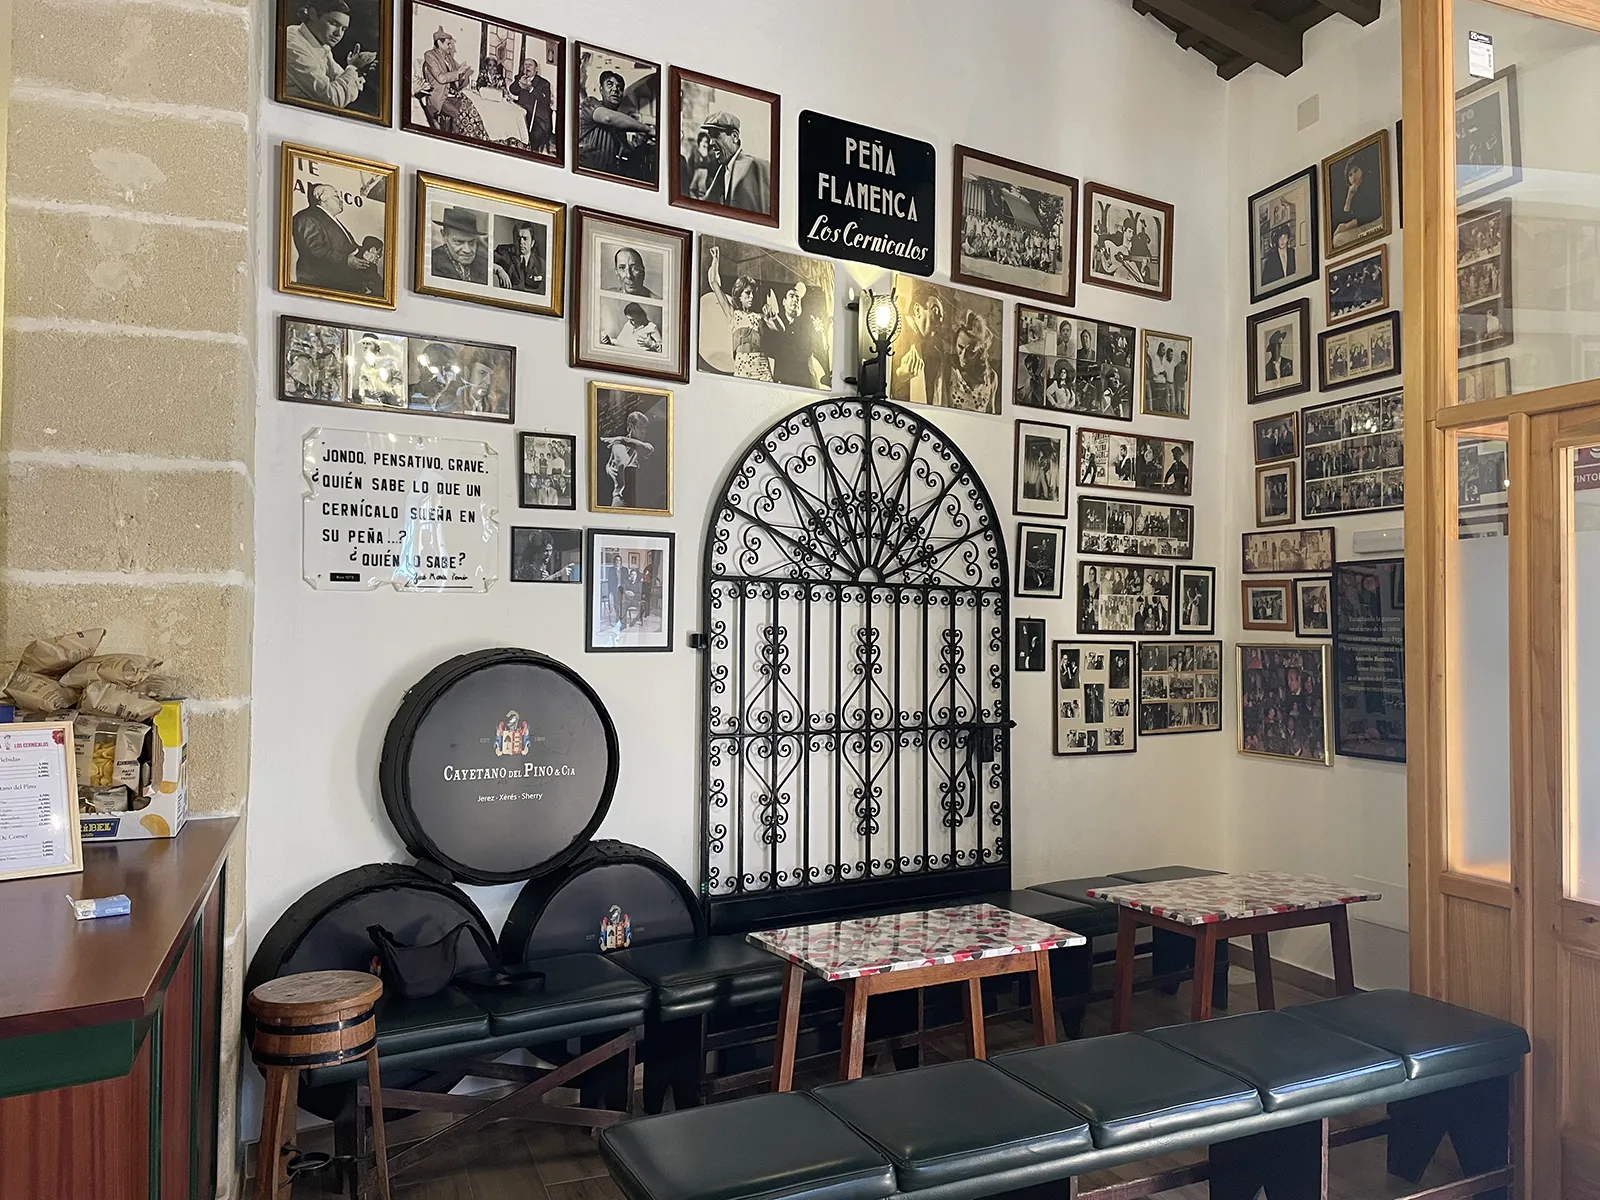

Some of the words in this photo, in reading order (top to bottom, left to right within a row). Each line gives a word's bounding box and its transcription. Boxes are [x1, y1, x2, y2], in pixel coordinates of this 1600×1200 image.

[845, 136, 896, 176] PEÑA
[818, 172, 918, 222] FLAMENCA
[807, 214, 841, 243] Los
[843, 221, 929, 261] Cernicalos
[371, 477, 405, 493] SABE
[413, 480, 429, 494] LO
[437, 482, 460, 496] QUE
[466, 484, 481, 497] UN
[322, 498, 399, 519] CERNÍCALO
[460, 510, 476, 523] EN
[322, 529, 339, 543] SU
[426, 552, 466, 569] SABE?
[443, 765, 507, 782] CAYETANO
[508, 770, 523, 779] DEL
[523, 762, 553, 778] PINO
[477, 794, 495, 803] Jerez
[521, 791, 544, 801] Sherry
